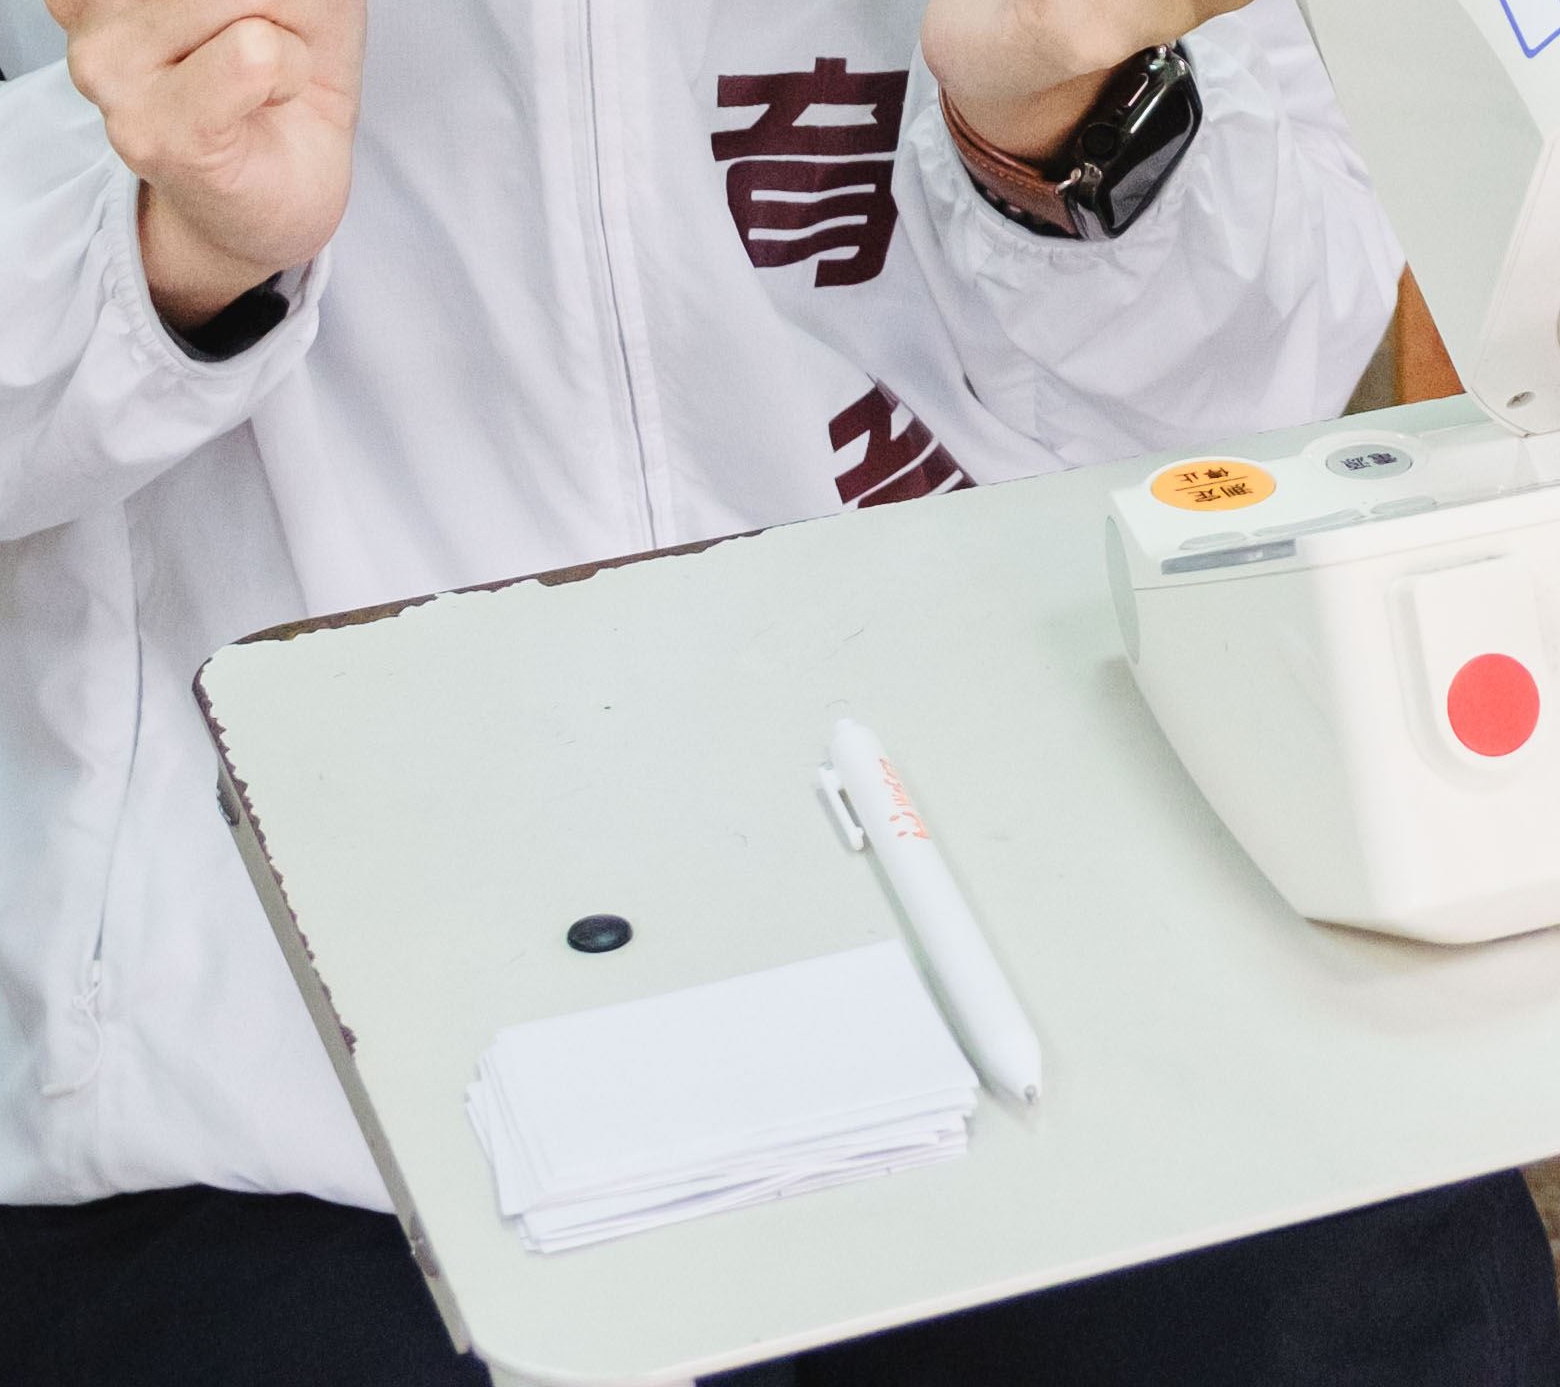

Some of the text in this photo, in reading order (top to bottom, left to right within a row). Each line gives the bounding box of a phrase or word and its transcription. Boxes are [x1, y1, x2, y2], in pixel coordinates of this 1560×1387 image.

[1341, 452, 1397, 470] 電源
[1174, 466, 1229, 484] 停止
[1188, 482, 1254, 503] 測定
